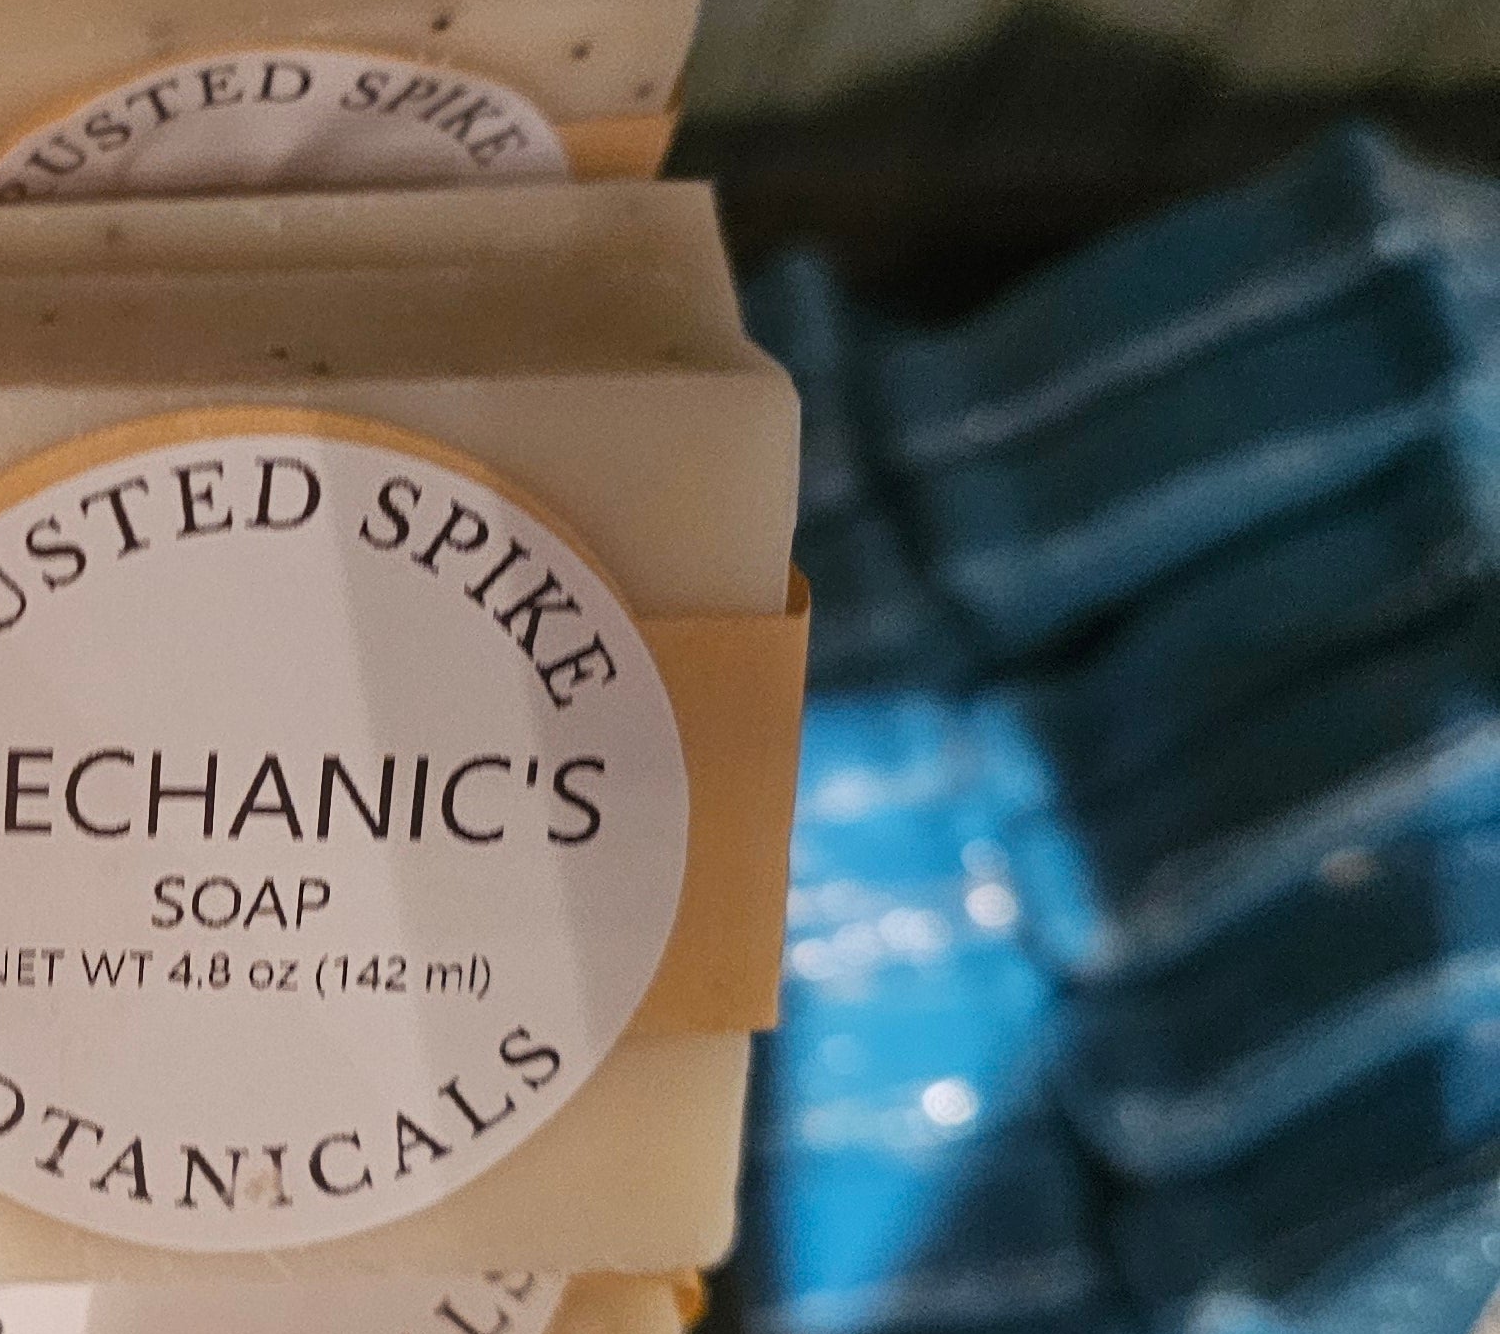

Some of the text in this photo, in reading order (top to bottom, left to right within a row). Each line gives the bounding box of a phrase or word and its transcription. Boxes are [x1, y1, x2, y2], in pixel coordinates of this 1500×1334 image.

[340, 68, 527, 167] SPIKE
[359, 476, 616, 710] SPIKE
[150, 876, 331, 930] SOAP
[80, 949, 155, 990] WT
[166, 950, 232, 991] 4.8
[247, 958, 299, 992] oz
[314, 953, 408, 1000] (142
[424, 952, 491, 1001] ml)
